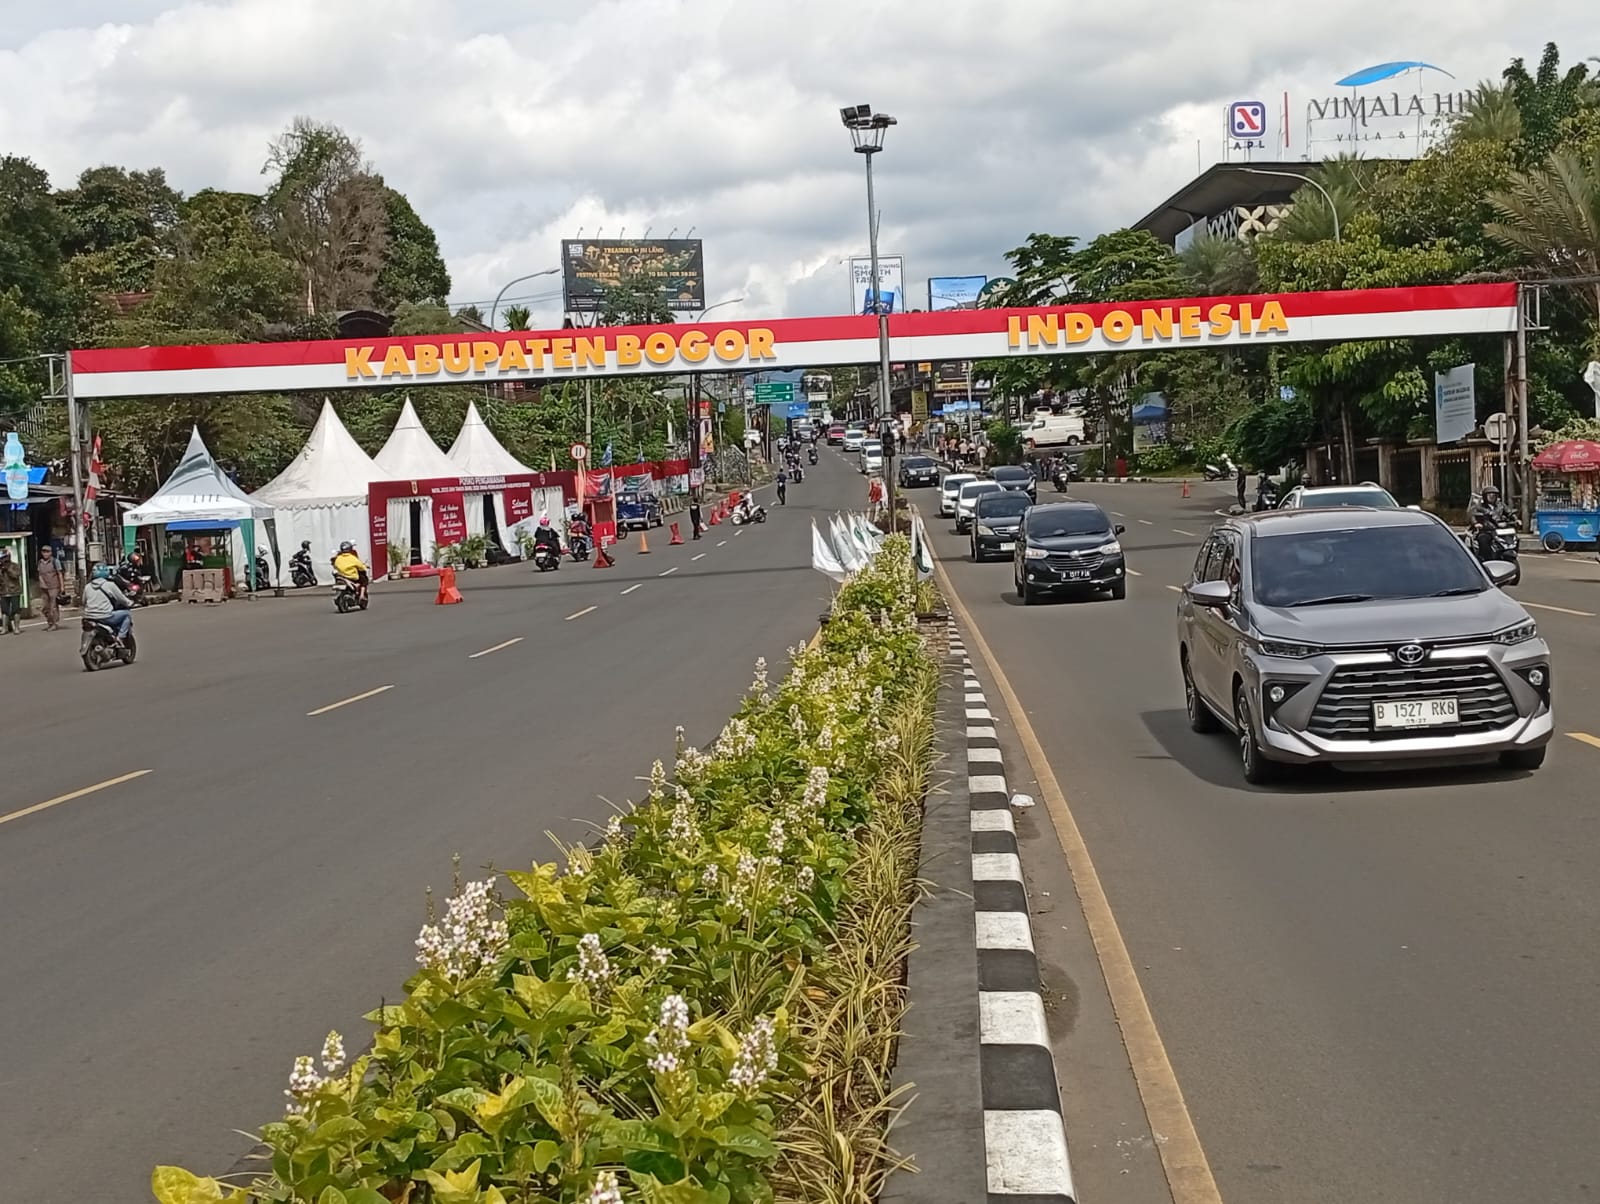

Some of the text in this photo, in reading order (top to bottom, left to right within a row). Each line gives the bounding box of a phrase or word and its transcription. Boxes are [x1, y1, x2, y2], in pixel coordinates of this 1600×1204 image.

[1310, 92, 1424, 127] VIMALA
[1233, 140, 1265, 150] APL
[1336, 132, 1382, 142] VILLA
[1007, 300, 1289, 348] INDONESIA
[344, 328, 777, 379] KABUPATEN BOGOR
[1377, 705, 1385, 720] B
[1394, 702, 1423, 718] 1527
